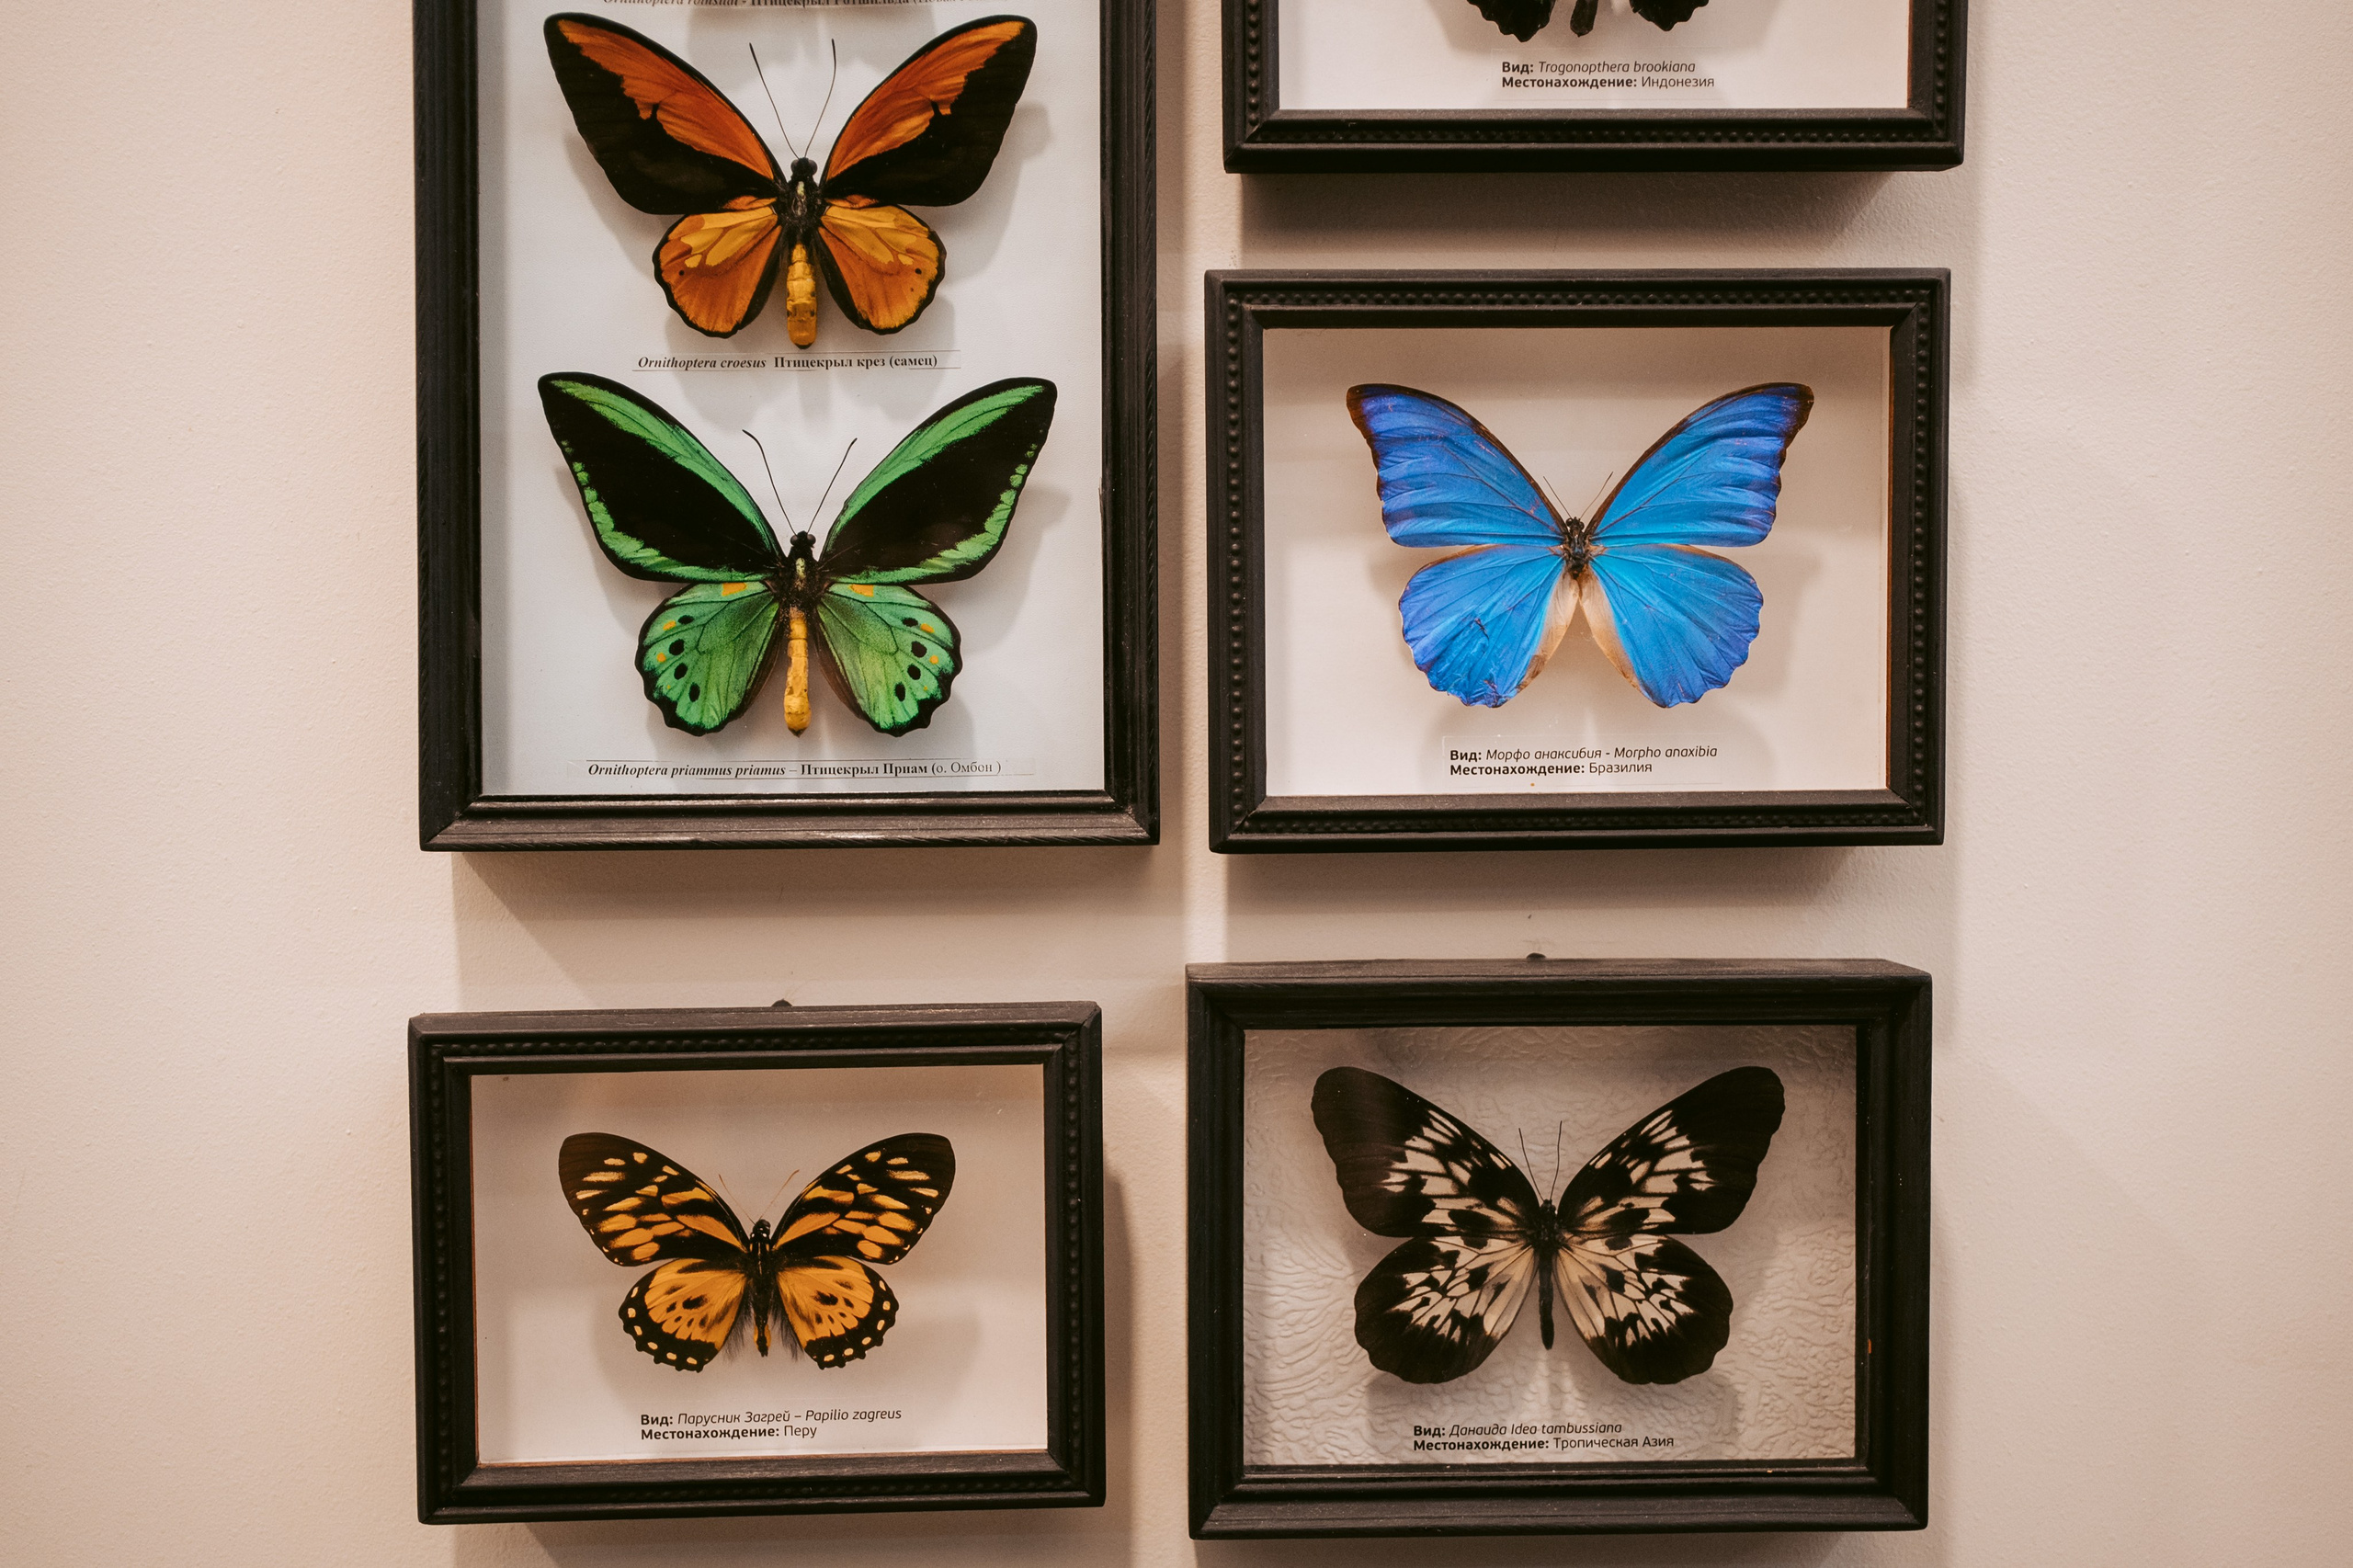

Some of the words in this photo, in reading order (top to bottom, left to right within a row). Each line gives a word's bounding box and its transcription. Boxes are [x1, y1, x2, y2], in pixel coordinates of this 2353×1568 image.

[1502, 62, 1534, 74] Вид:
[1539, 61, 1630, 75] Trogonopthera
[1633, 61, 1696, 73] brookiana
[1502, 76, 1637, 89] Местонахождение:
[1642, 76, 1715, 89] Индонезия
[638, 357, 717, 371] Ornithoptera
[720, 358, 767, 369] croesus
[774, 356, 853, 370] Птицекрыл
[857, 357, 886, 370] крез
[889, 355, 938, 369] (самец)
[1449, 749, 1483, 762] Вид:
[1485, 748, 1530, 762] Морфо
[1534, 746, 1602, 760] анаксибия
[1614, 745, 1661, 759] Morpho
[1665, 744, 1718, 758] anaxibia
[587, 764, 668, 778] Ornithoptera
[670, 765, 733, 778] priammus
[734, 765, 786, 778] priamus
[801, 763, 880, 778] Птицекрыл
[882, 763, 927, 778] Приам
[1449, 763, 1586, 776] Местонахождение:
[1589, 762, 1653, 776] Бразилия
[640, 1414, 674, 1426] Вид:
[677, 1413, 741, 1427] Парусник
[744, 1410, 790, 1426] Загрей
[805, 1409, 849, 1424] Papilio
[852, 1408, 902, 1423] zagreus
[641, 1426, 779, 1440] Местонахождение:
[783, 1425, 817, 1438] Перу
[1413, 1425, 1446, 1437] Вид:
[1449, 1423, 1507, 1437] Данаида
[1510, 1422, 1538, 1436] Idea
[1540, 1421, 1623, 1435] tambussiana
[1413, 1438, 1550, 1452] Местонахождение:
[1553, 1437, 1639, 1450] Тропическая
[1642, 1436, 1675, 1449] Азия
